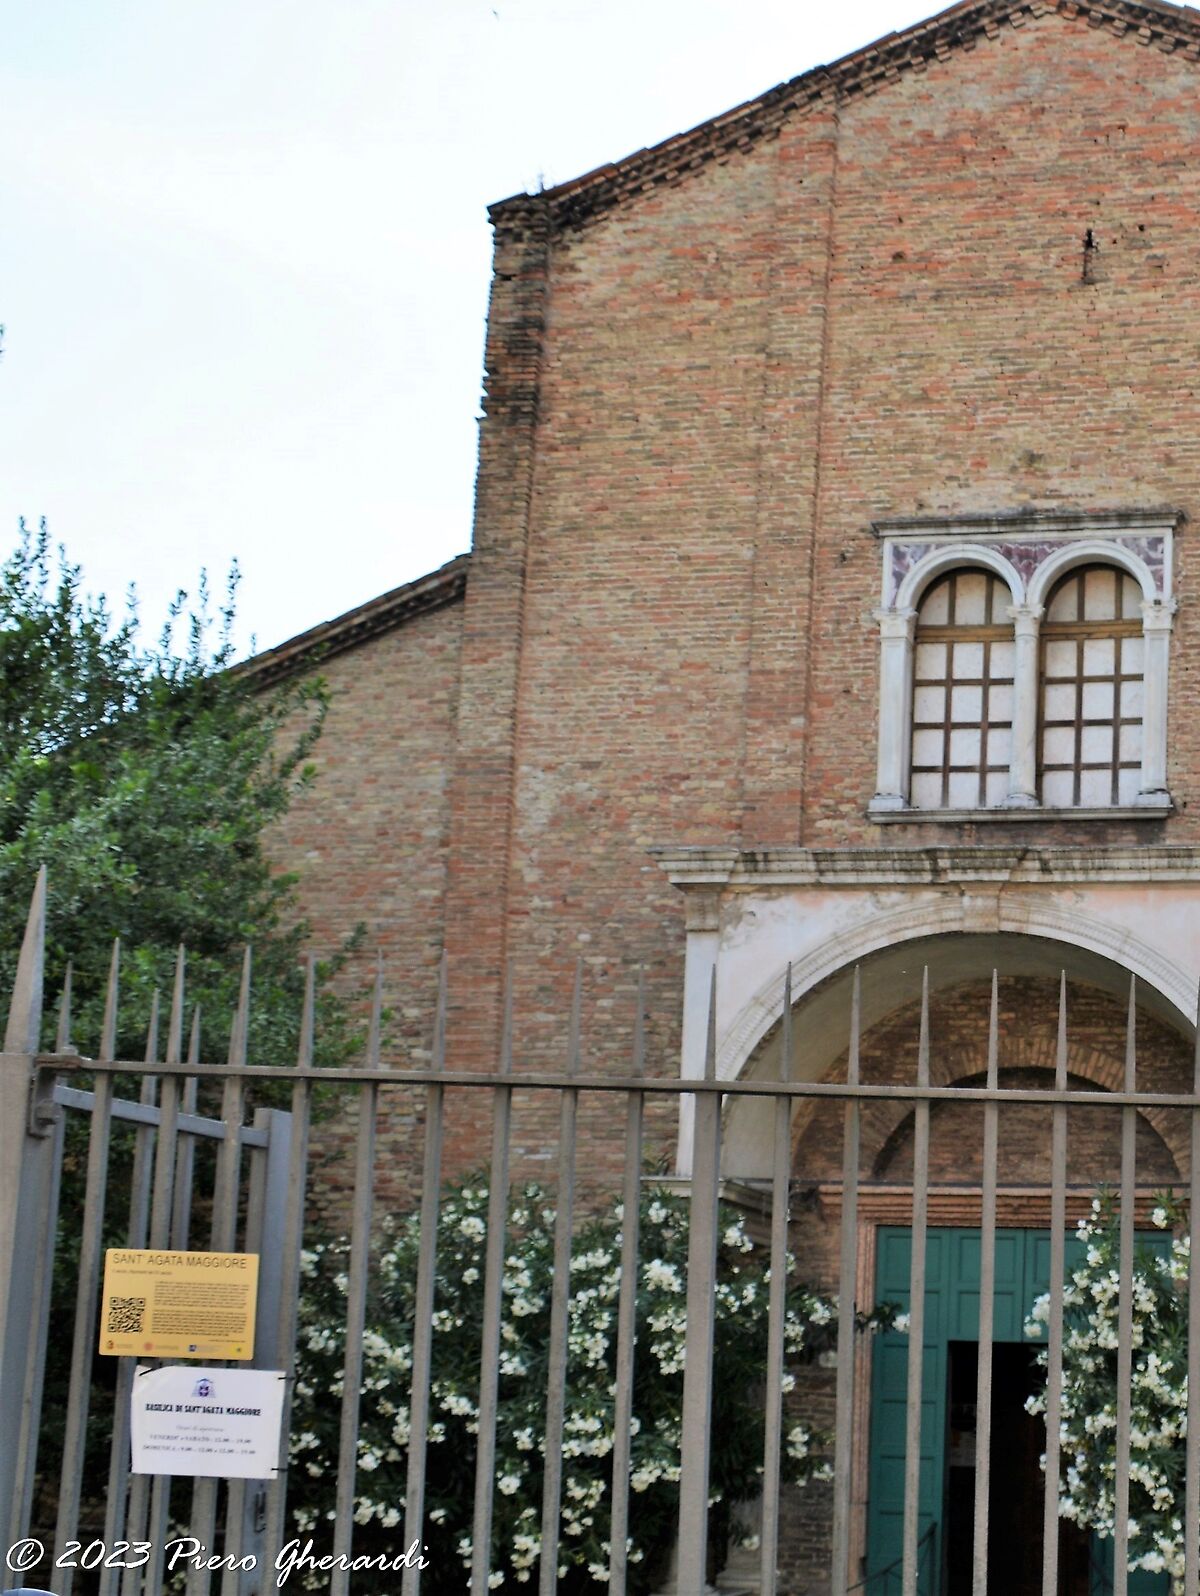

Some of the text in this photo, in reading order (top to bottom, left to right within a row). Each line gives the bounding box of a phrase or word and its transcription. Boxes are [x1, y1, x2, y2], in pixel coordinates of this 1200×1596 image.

[147, 1255, 183, 1266] AGATA
[187, 1257, 248, 1269] MAGGIORE
[145, 1403, 173, 1412] BASILICA
[175, 1404, 183, 1413] DI
[226, 1407, 261, 1416] MAGGIORE
